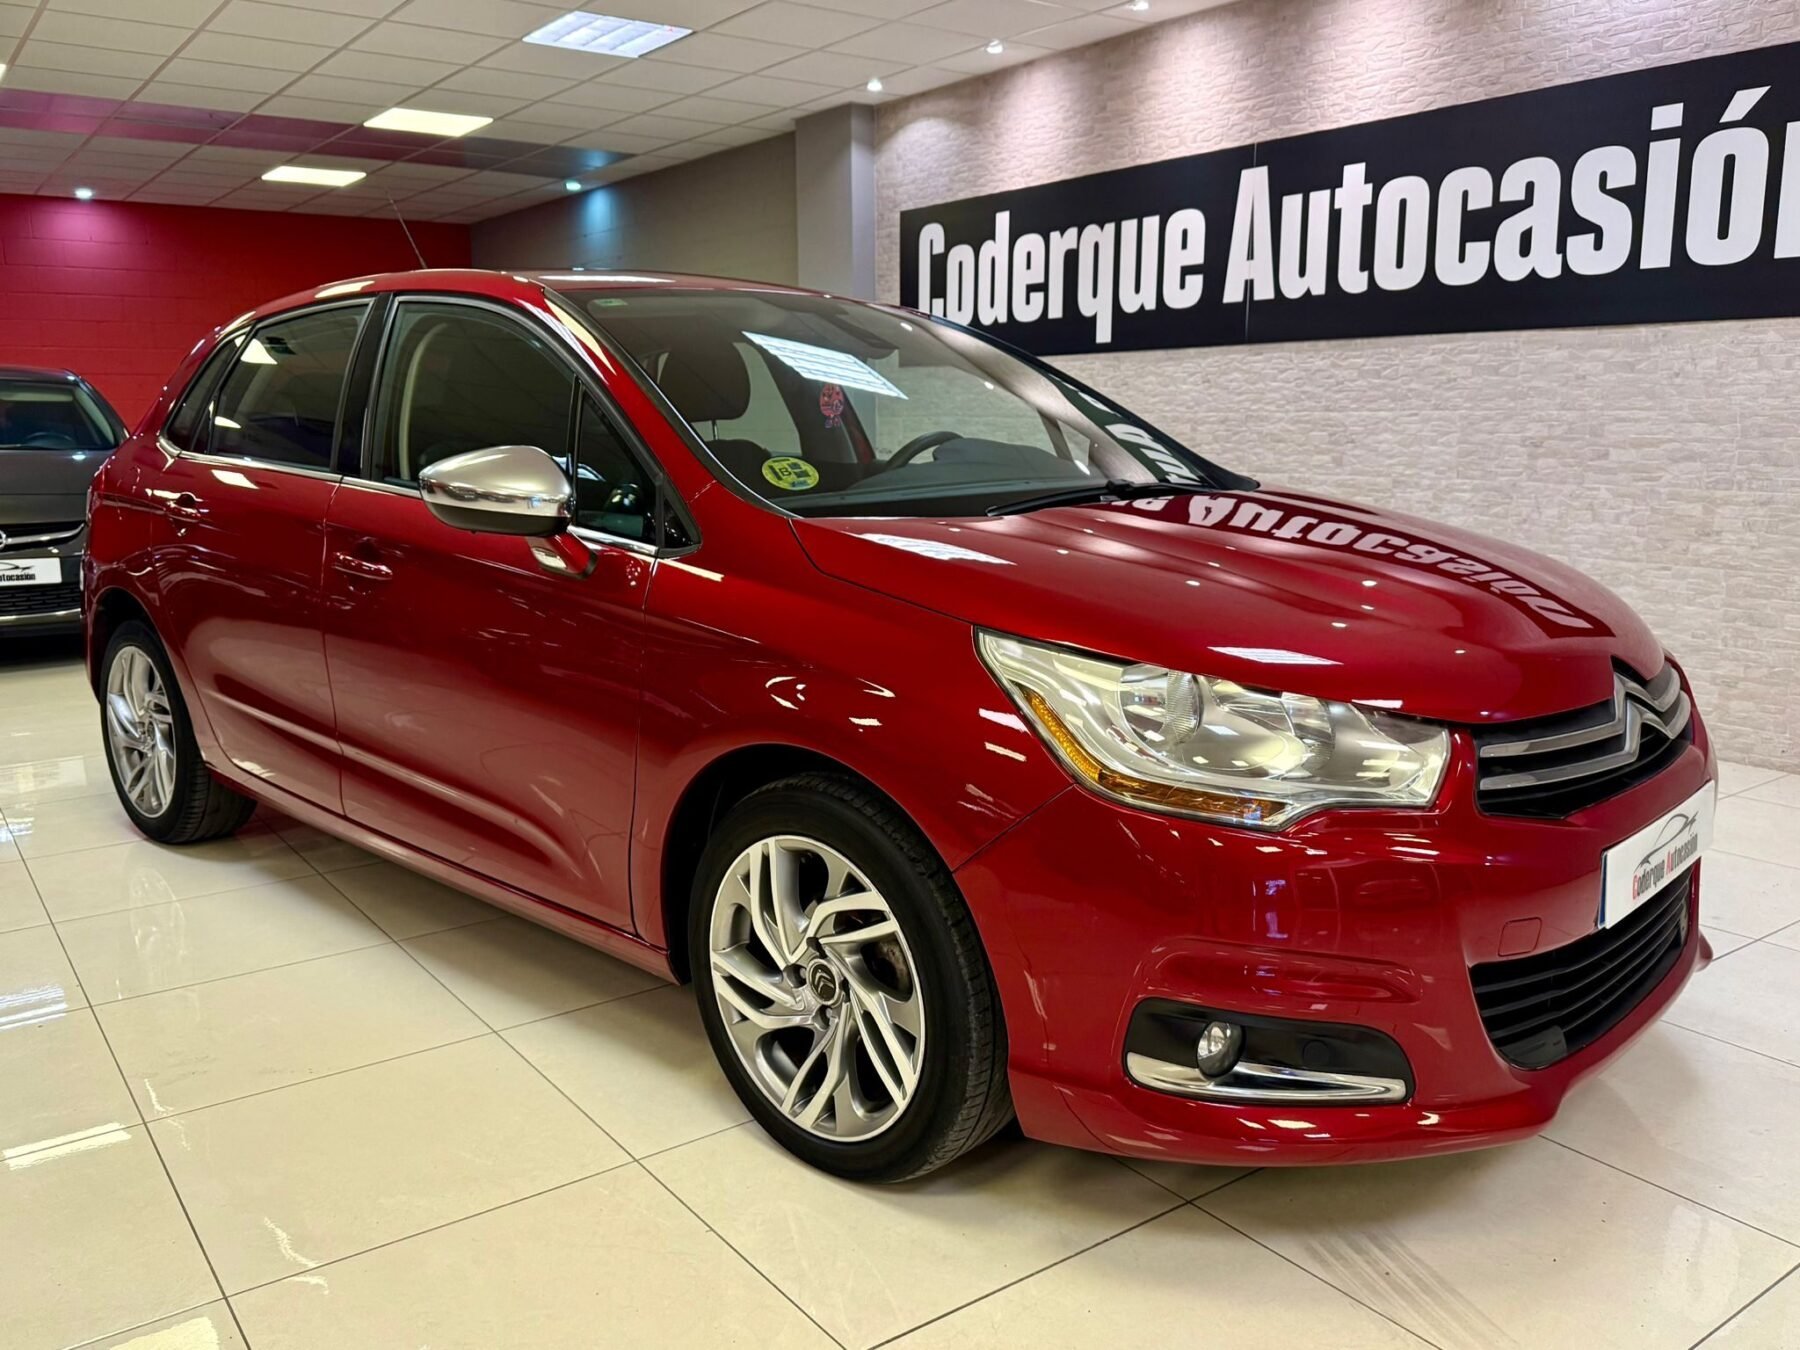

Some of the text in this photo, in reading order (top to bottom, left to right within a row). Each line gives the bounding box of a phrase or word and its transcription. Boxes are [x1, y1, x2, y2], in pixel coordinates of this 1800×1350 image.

[918, 207, 1206, 343] Coderque
[1633, 832, 1698, 900] Coderque Autocasión
